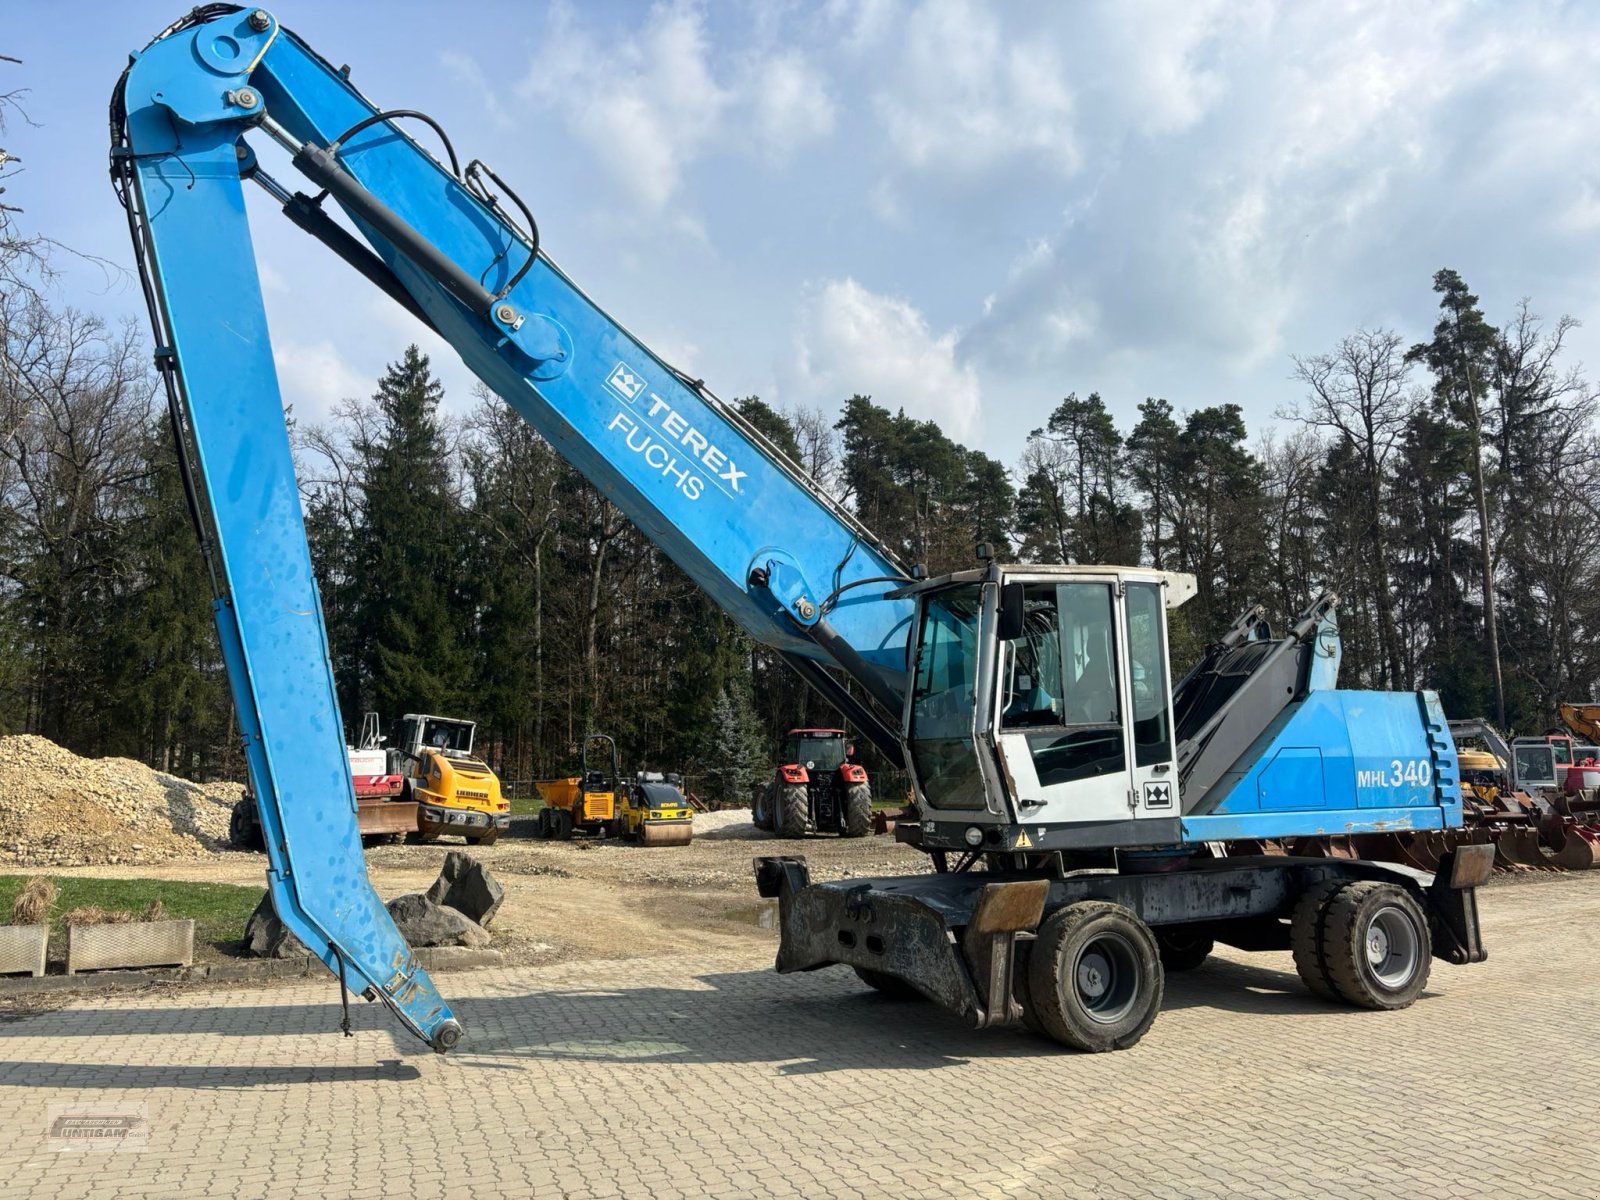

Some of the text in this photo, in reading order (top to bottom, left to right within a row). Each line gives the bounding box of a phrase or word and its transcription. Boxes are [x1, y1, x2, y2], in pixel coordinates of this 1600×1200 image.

[608, 412, 705, 500] FUCHS
[648, 392, 748, 493] TEREX
[456, 789, 489, 799] LIEBHERR
